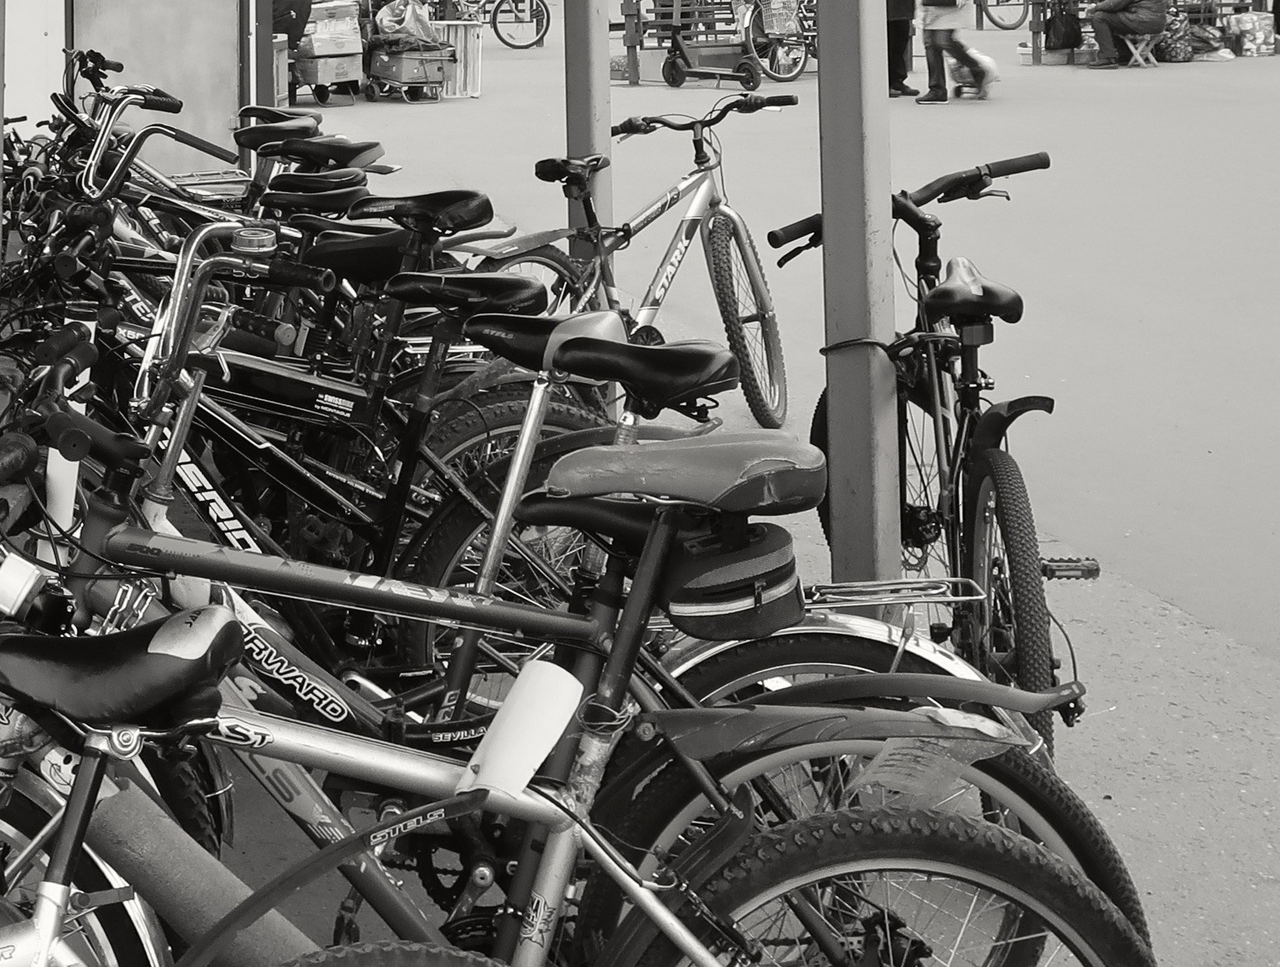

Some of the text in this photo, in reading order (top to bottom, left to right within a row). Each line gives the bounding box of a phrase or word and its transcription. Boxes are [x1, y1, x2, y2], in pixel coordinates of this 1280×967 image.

[656, 231, 690, 303] STARK
[483, 328, 513, 339] STELS
[242, 624, 349, 723] RWARD
[370, 808, 446, 846] STELS
